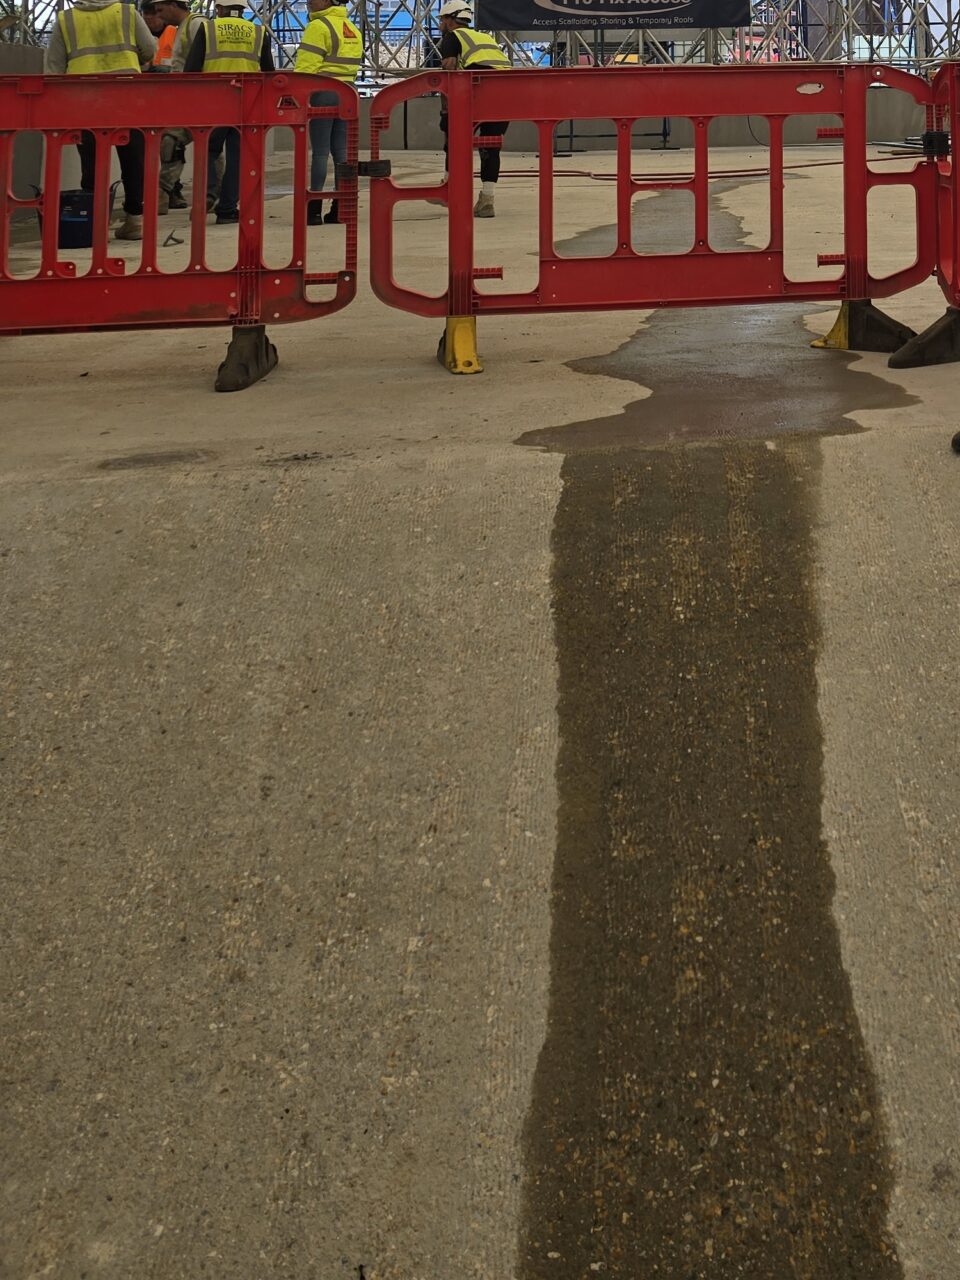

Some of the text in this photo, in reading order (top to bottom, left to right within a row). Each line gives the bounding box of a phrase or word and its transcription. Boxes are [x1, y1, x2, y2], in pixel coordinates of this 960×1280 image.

[532, 18, 557, 26] Access
[600, 17, 627, 26] Shoring
[636, 16, 672, 25] Temporary
[673, 16, 694, 24] Roofs
